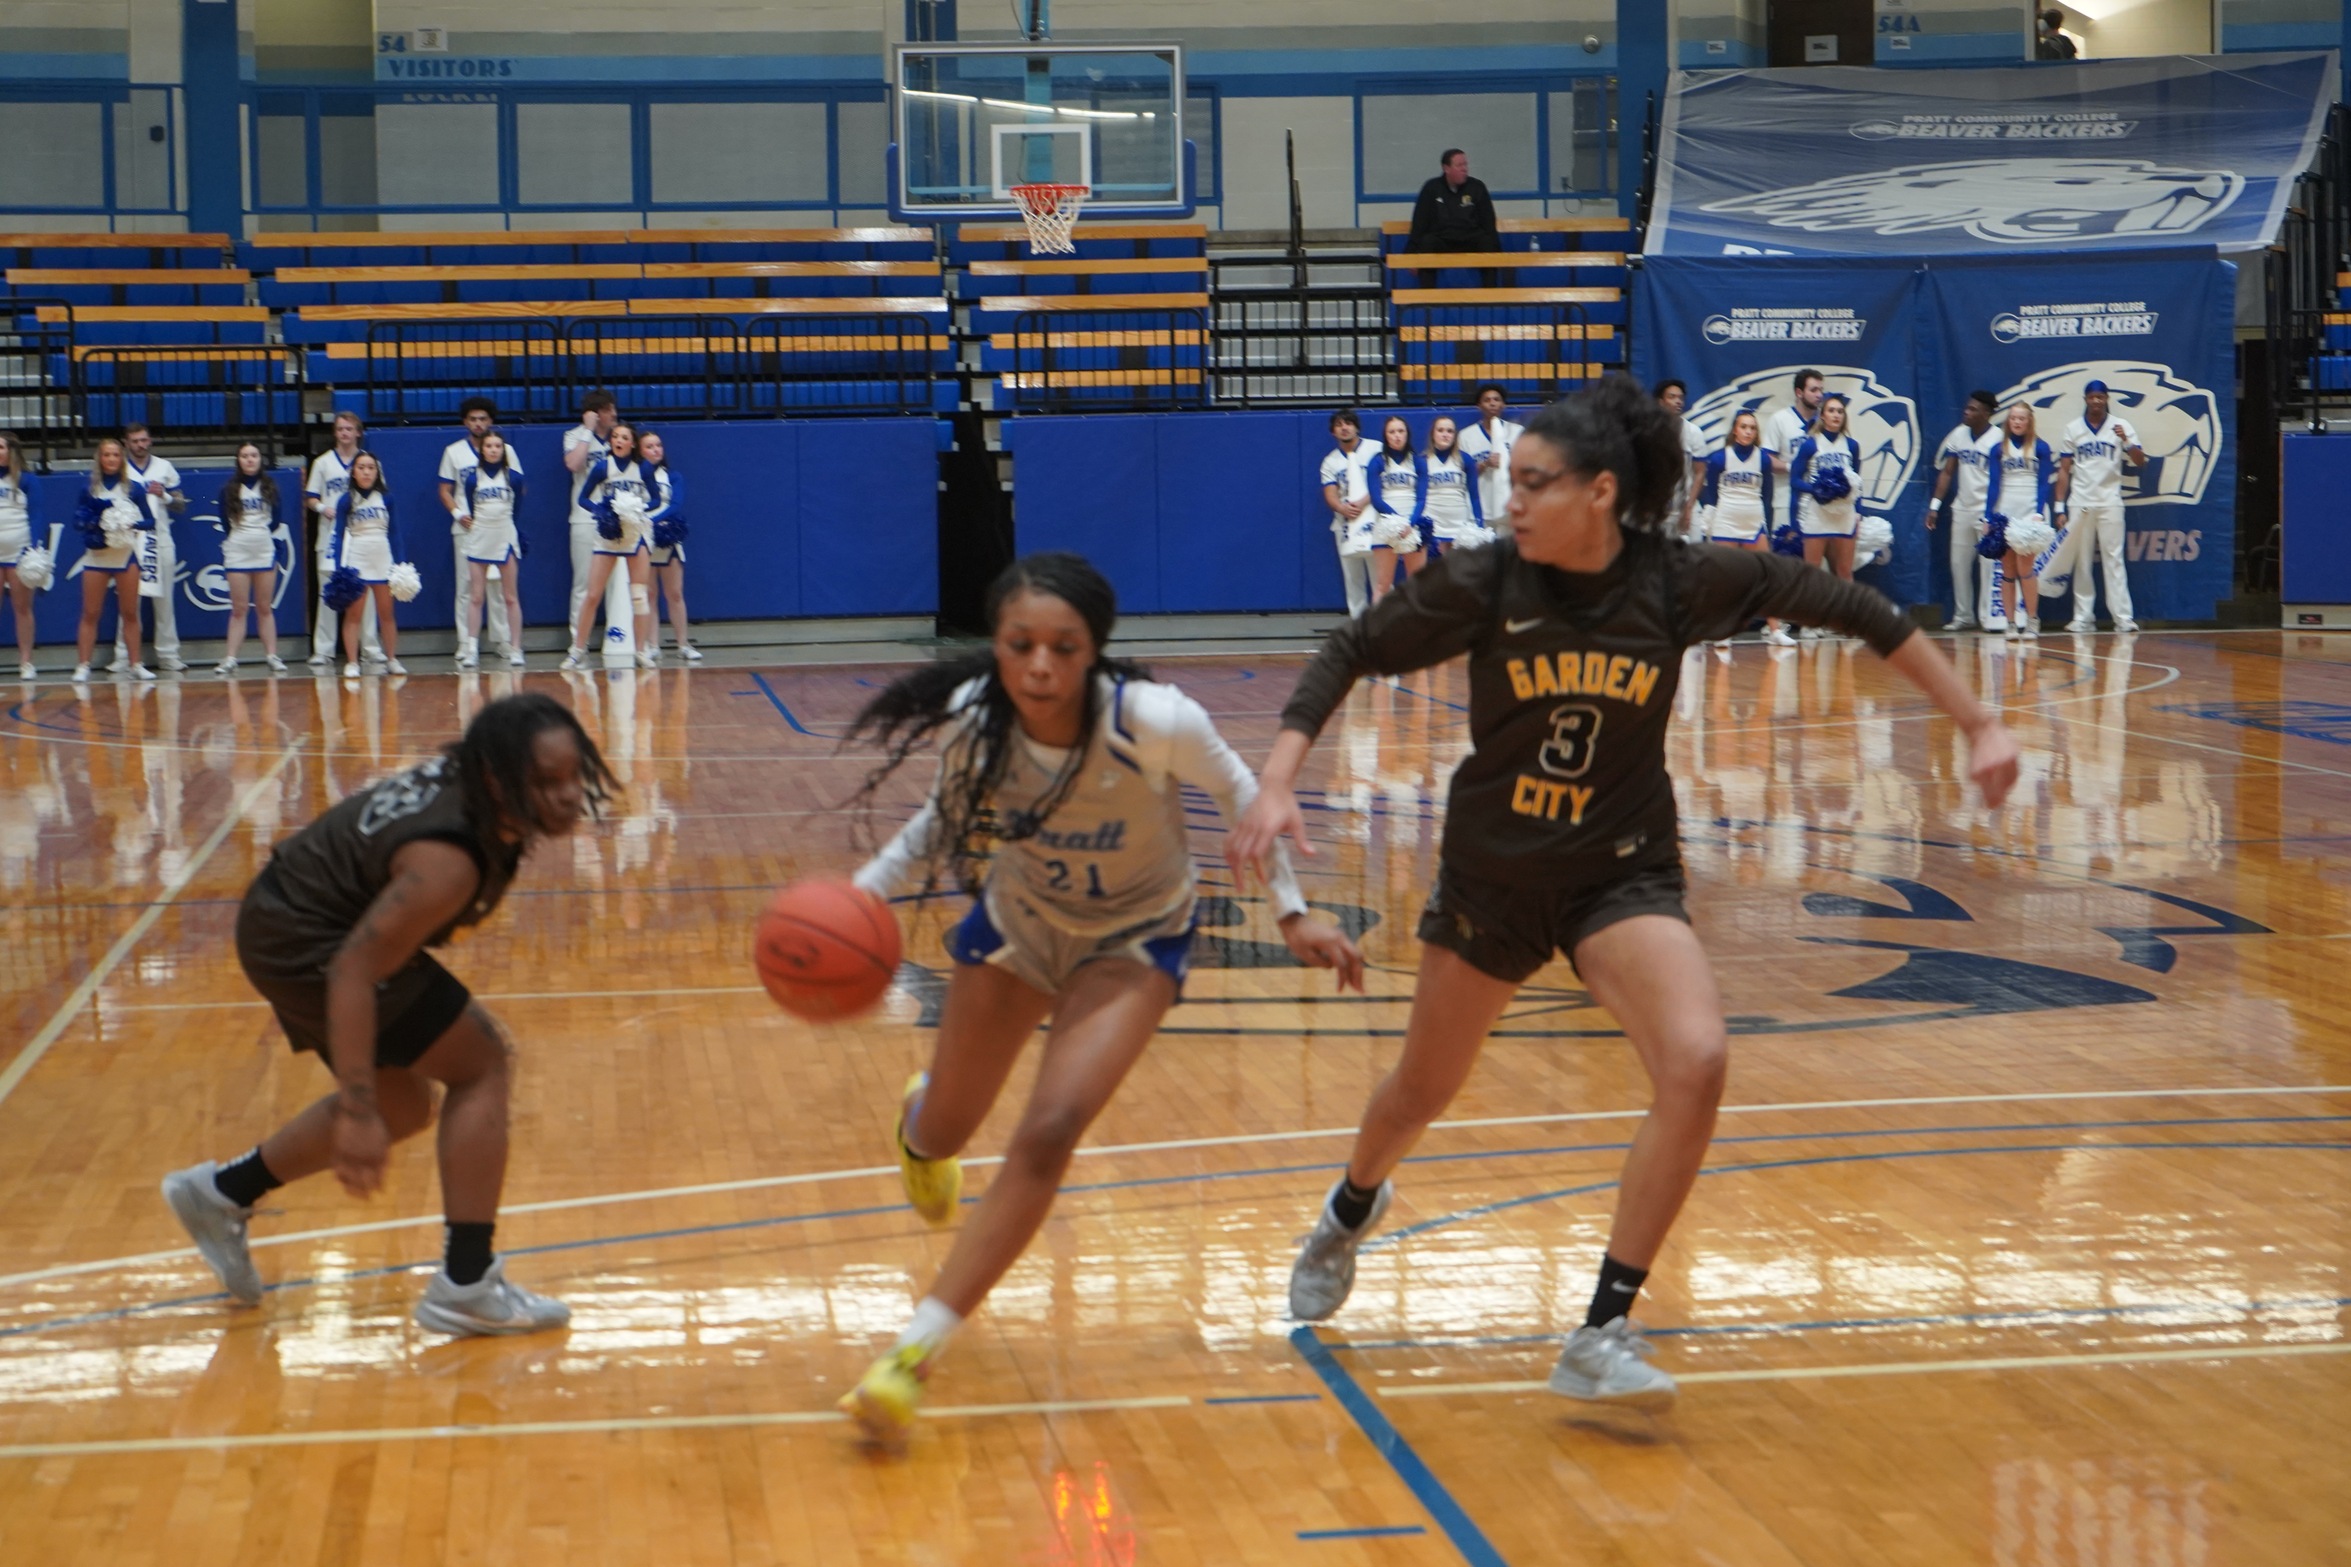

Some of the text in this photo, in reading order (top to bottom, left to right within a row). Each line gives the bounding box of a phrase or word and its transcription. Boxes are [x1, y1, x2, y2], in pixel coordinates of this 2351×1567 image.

[1877, 15, 1921, 33] 54A
[377, 35, 407, 53] 54
[388, 59, 513, 77] VISITORS
[1903, 112, 2118, 123] PRATT COMMUNITY COLLEGE
[1897, 121, 2127, 138] BEAVER BACKERS
[1730, 308, 1855, 318] PRATT COMMUNITY COLLEGE
[2019, 301, 2147, 315] PRATT COMMUNITY COLLEGE
[1730, 321, 1861, 339] BEAVER BACKERS
[2019, 315, 2153, 336] BEAVER BACKERS
[2077, 441, 2116, 462] PRATT
[2001, 457, 2039, 470] PRAT
[1381, 472, 1419, 489] PRATT
[1427, 470, 1467, 488] PRATT
[1724, 471, 1762, 487] PRATT
[351, 506, 391, 525] PRATT
[2034, 527, 2070, 577] BEAVER
[2126, 529, 2203, 562] VERS
[143, 533, 158, 583] AVERS
[1991, 561, 2006, 617] EAVERS
[1507, 652, 1660, 706] GARDEN
[1538, 703, 1604, 778] 3
[1511, 774, 1594, 825] CITY
[1045, 859, 1106, 897] 21
